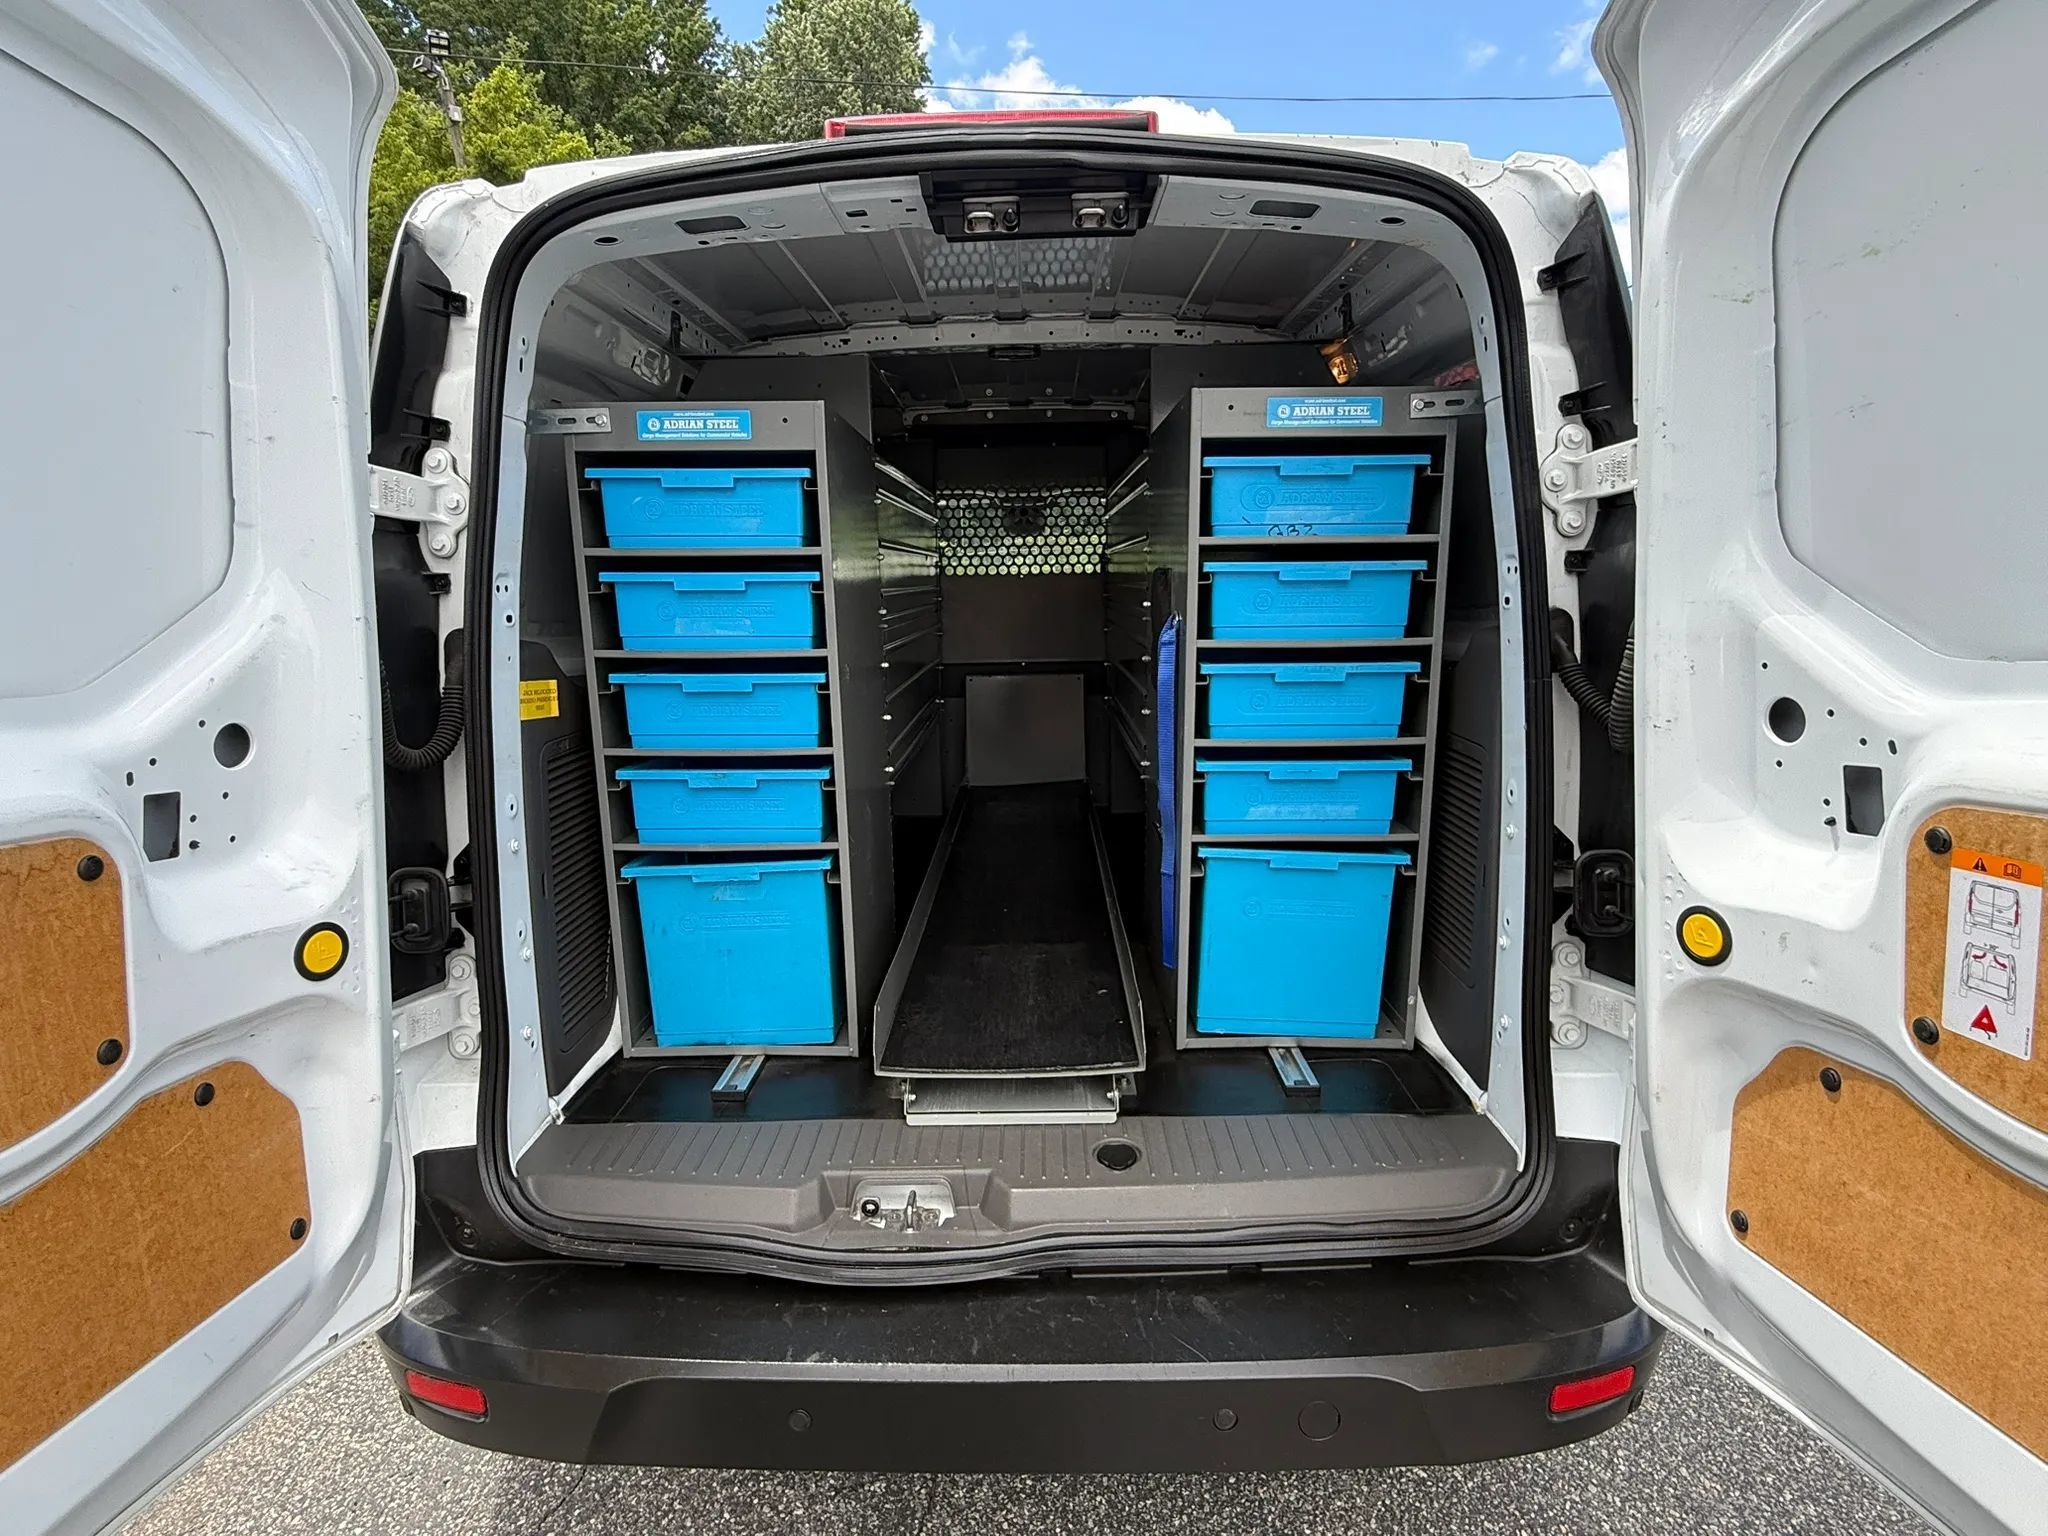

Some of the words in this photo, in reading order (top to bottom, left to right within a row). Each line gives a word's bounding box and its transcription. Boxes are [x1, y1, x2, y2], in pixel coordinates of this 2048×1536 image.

[1293, 406, 1334, 416] ADRIAN
[1337, 406, 1370, 416] STEEL
[663, 420, 704, 429] ADRIAN
[706, 420, 739, 429] STEEL
[1281, 491, 1330, 504] ADRIAN
